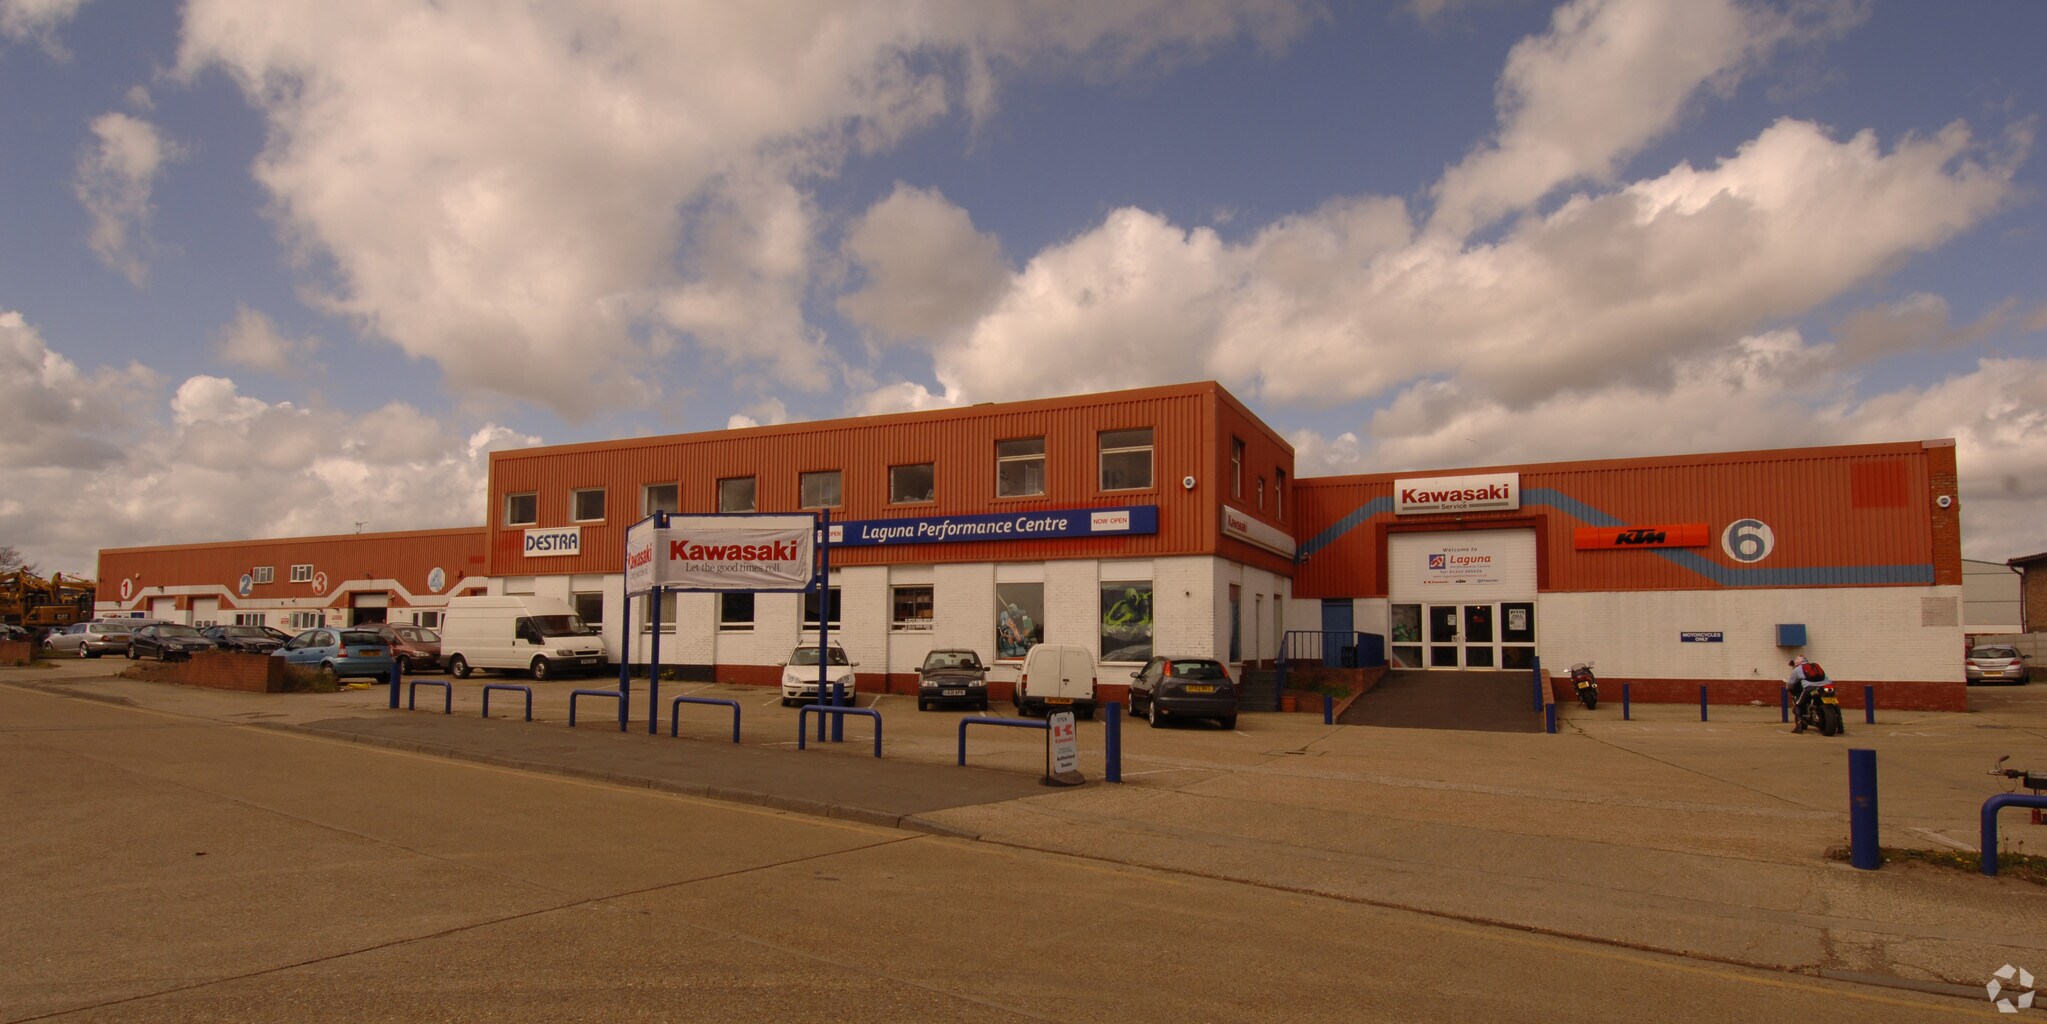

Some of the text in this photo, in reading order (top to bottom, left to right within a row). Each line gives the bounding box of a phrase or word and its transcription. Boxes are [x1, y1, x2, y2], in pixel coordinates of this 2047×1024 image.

[1402, 484, 1508, 504] Kawasaki
[862, 517, 1067, 543] Laguna Performance Centre
[1615, 529, 1665, 544] KTM
[526, 533, 578, 551] DESTRA
[1728, 519, 1765, 561] 6
[670, 540, 797, 561] Kawasaki
[686, 562, 699, 572] Let
[701, 562, 714, 572] the
[717, 563, 738, 574] good
[740, 563, 764, 572] times
[1450, 555, 1491, 566] Laguna
[122, 581, 129, 597] 1
[240, 575, 250, 595] 2
[314, 574, 325, 593] 3
[430, 569, 443, 591] 4
